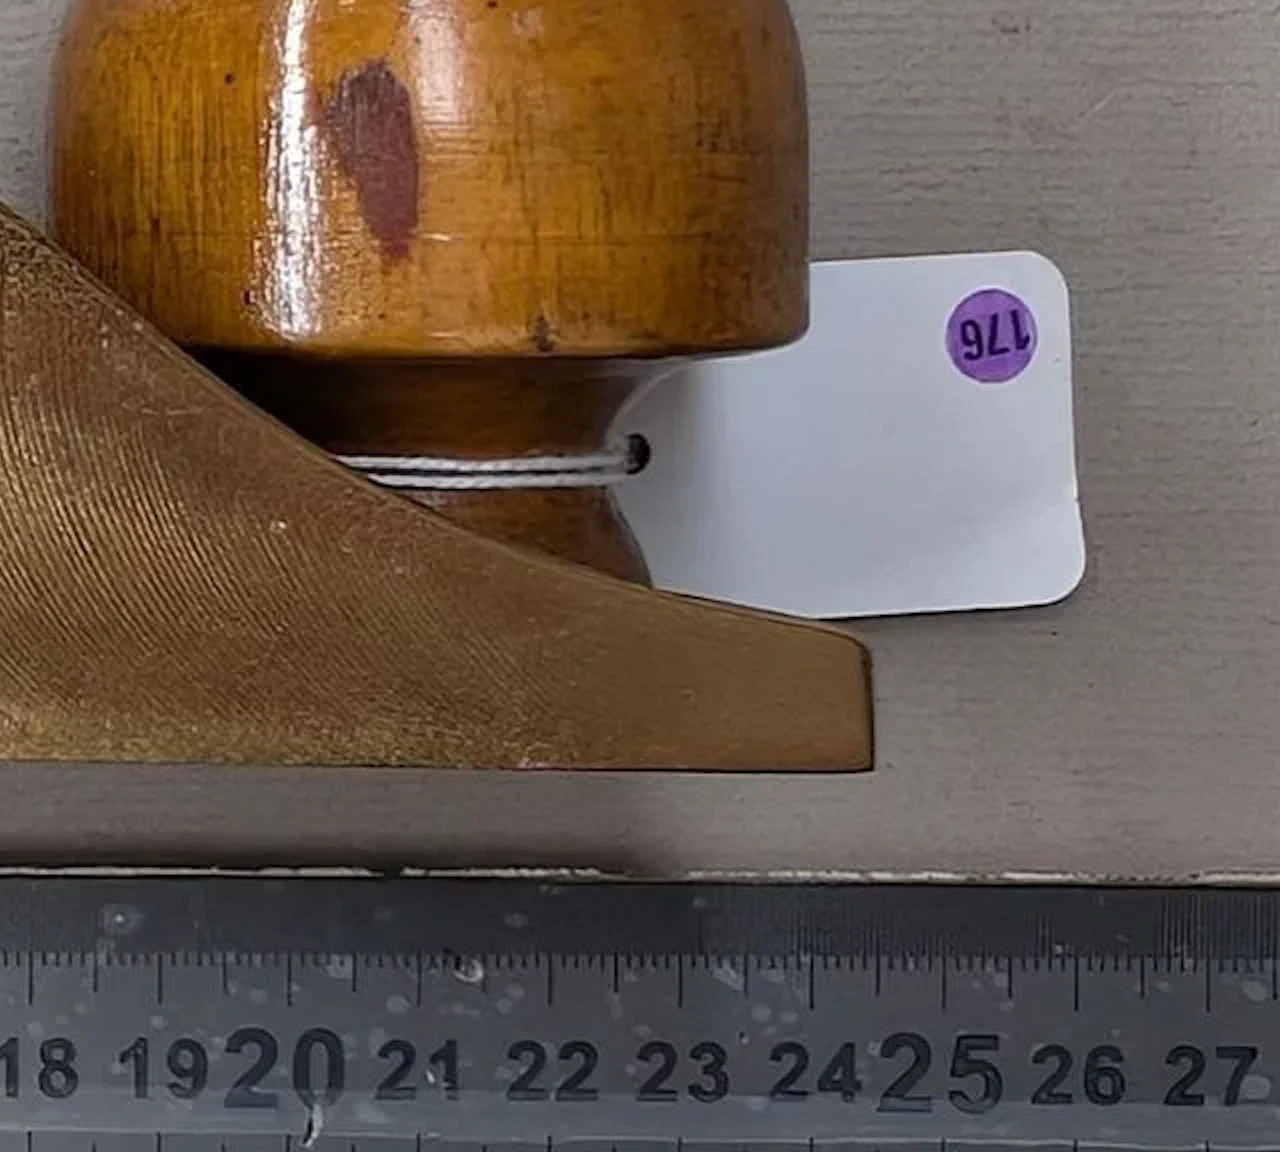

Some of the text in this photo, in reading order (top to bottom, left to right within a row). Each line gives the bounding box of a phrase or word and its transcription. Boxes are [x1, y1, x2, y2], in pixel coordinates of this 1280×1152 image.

[960, 309, 1030, 361] 176
[120, 1037, 209, 1100] 19
[224, 1028, 341, 1108] 20
[375, 1039, 458, 1101] 21
[506, 1039, 599, 1101] 22
[636, 1041, 729, 1103] 23
[768, 1042, 863, 1103] 24
[876, 1032, 1004, 1114] 25
[1031, 1044, 1126, 1104] 26
[1163, 1047, 1258, 1106] 27
